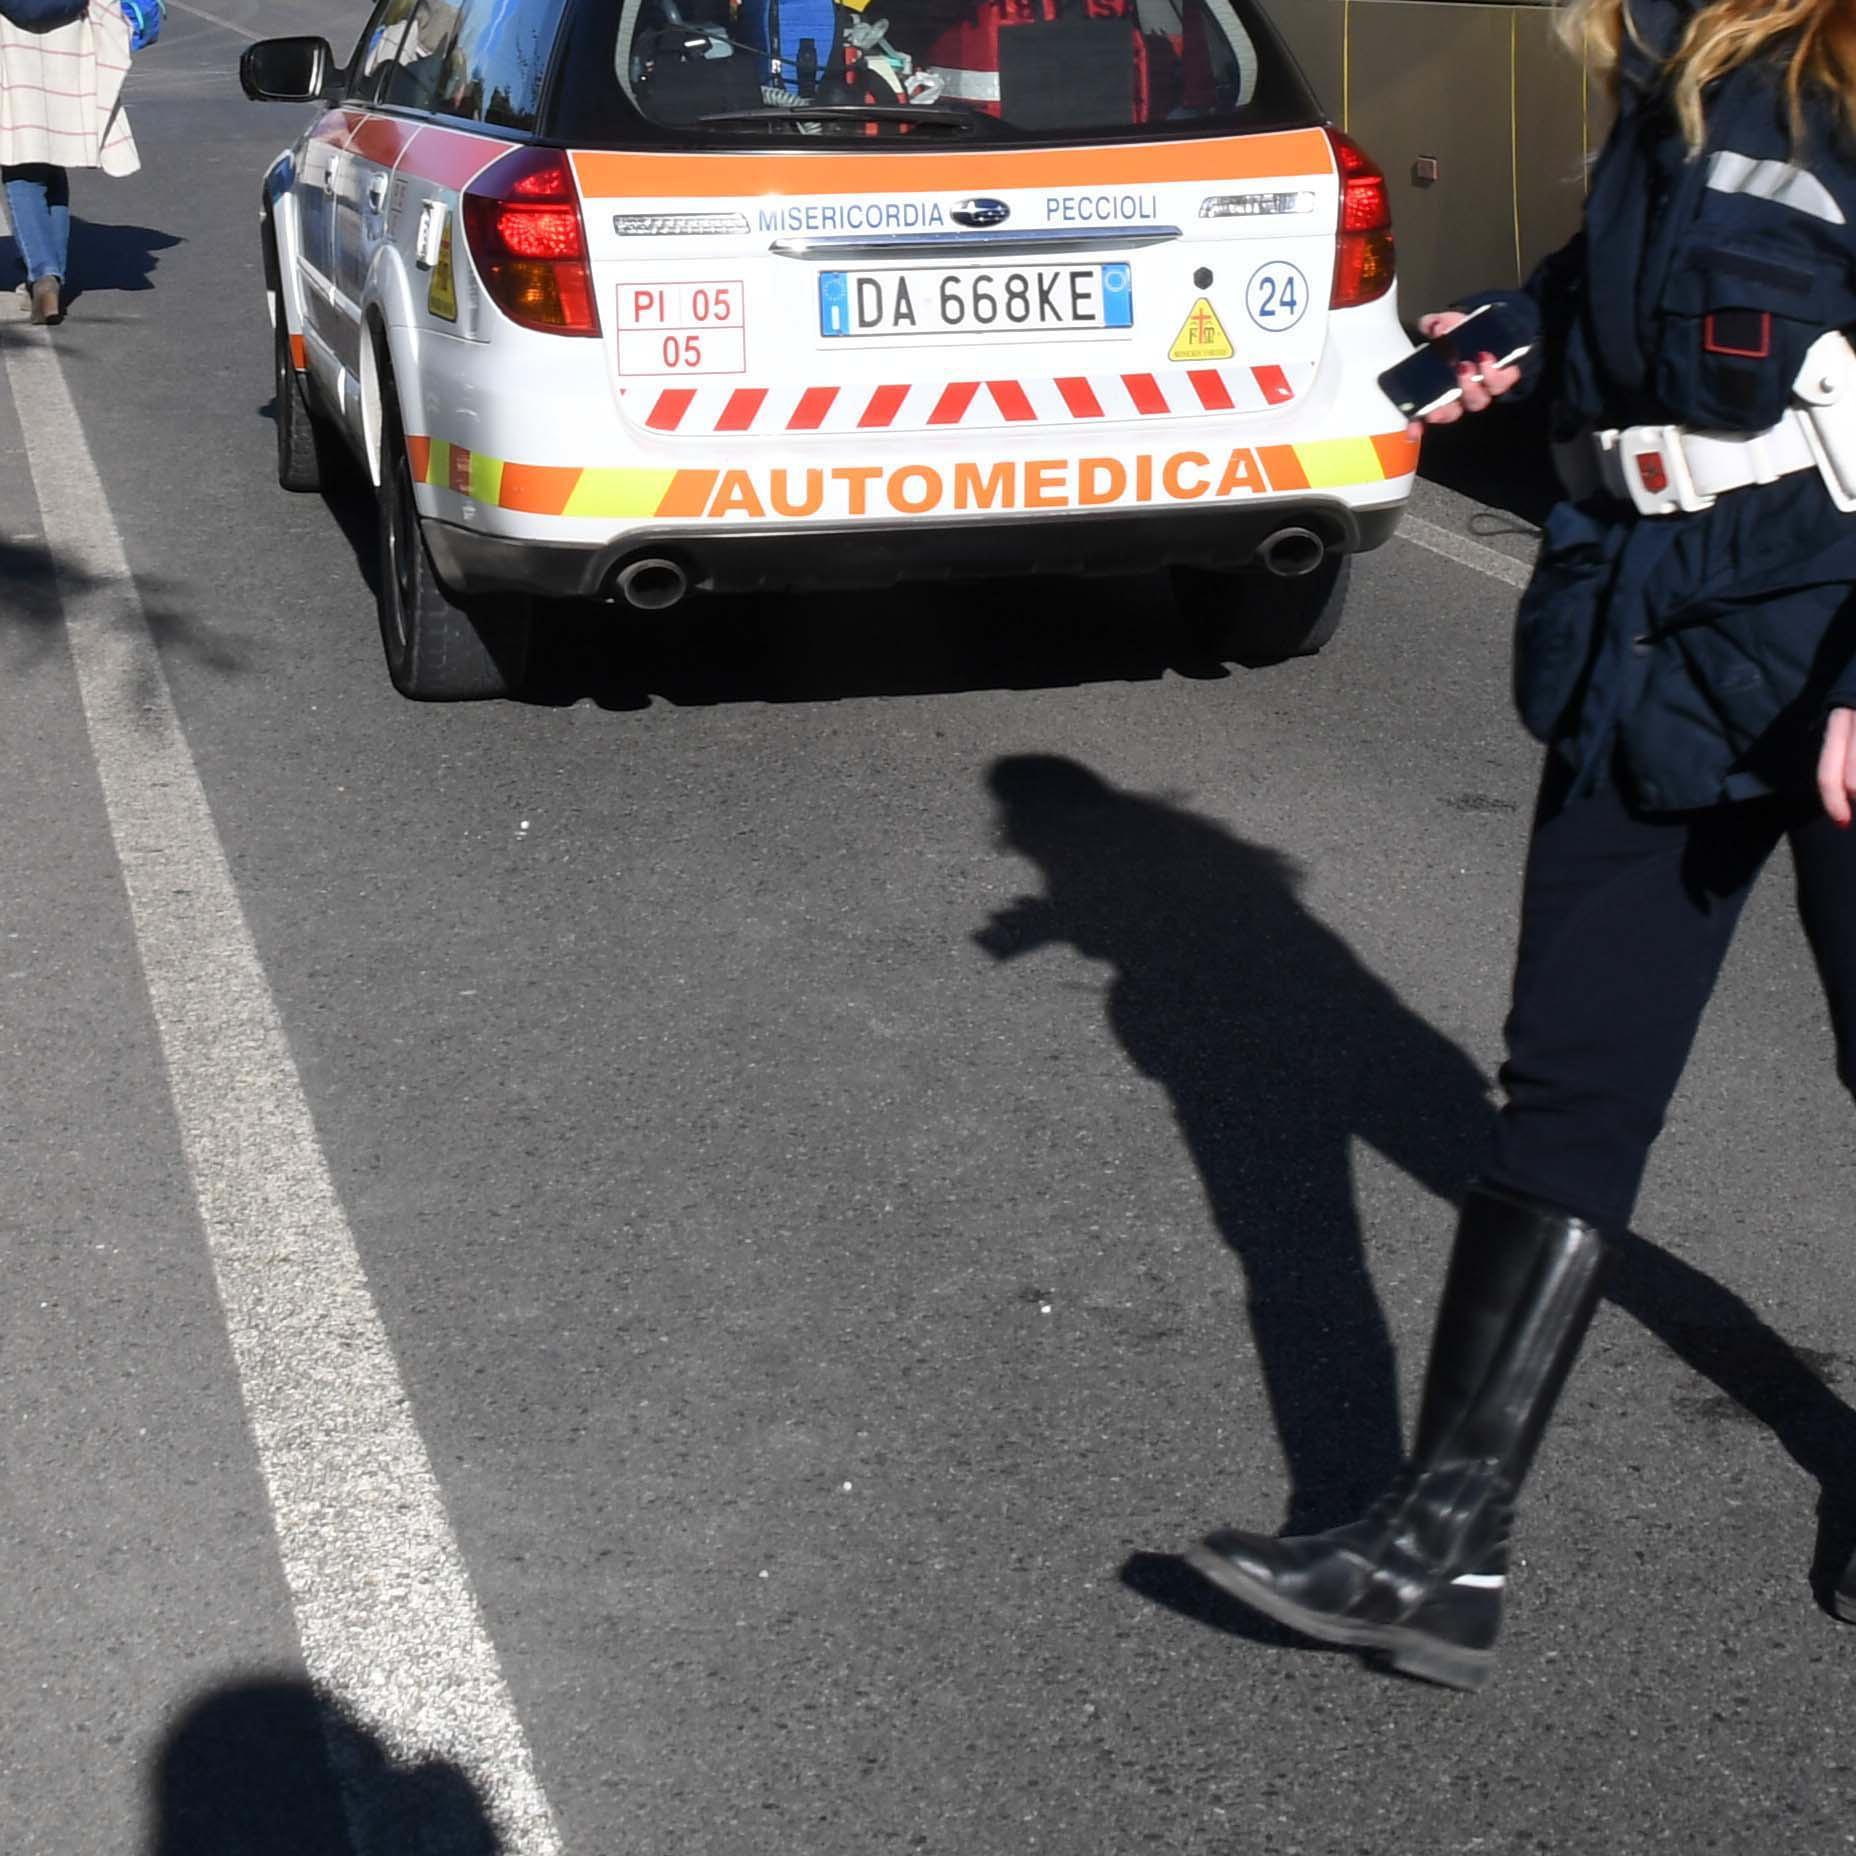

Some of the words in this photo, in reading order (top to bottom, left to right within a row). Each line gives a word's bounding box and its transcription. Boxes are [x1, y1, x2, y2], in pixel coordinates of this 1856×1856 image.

[758, 202, 945, 232] MISERICORDIA
[1045, 195, 1158, 221] PECCIOLI
[633, 289, 665, 323] PI
[692, 288, 732, 322] 05
[855, 275, 917, 328] DA
[940, 270, 1097, 324] 668KE
[1258, 276, 1297, 317] 24
[662, 335, 703, 368] 05
[707, 447, 1269, 518] AUTOMEDICA
